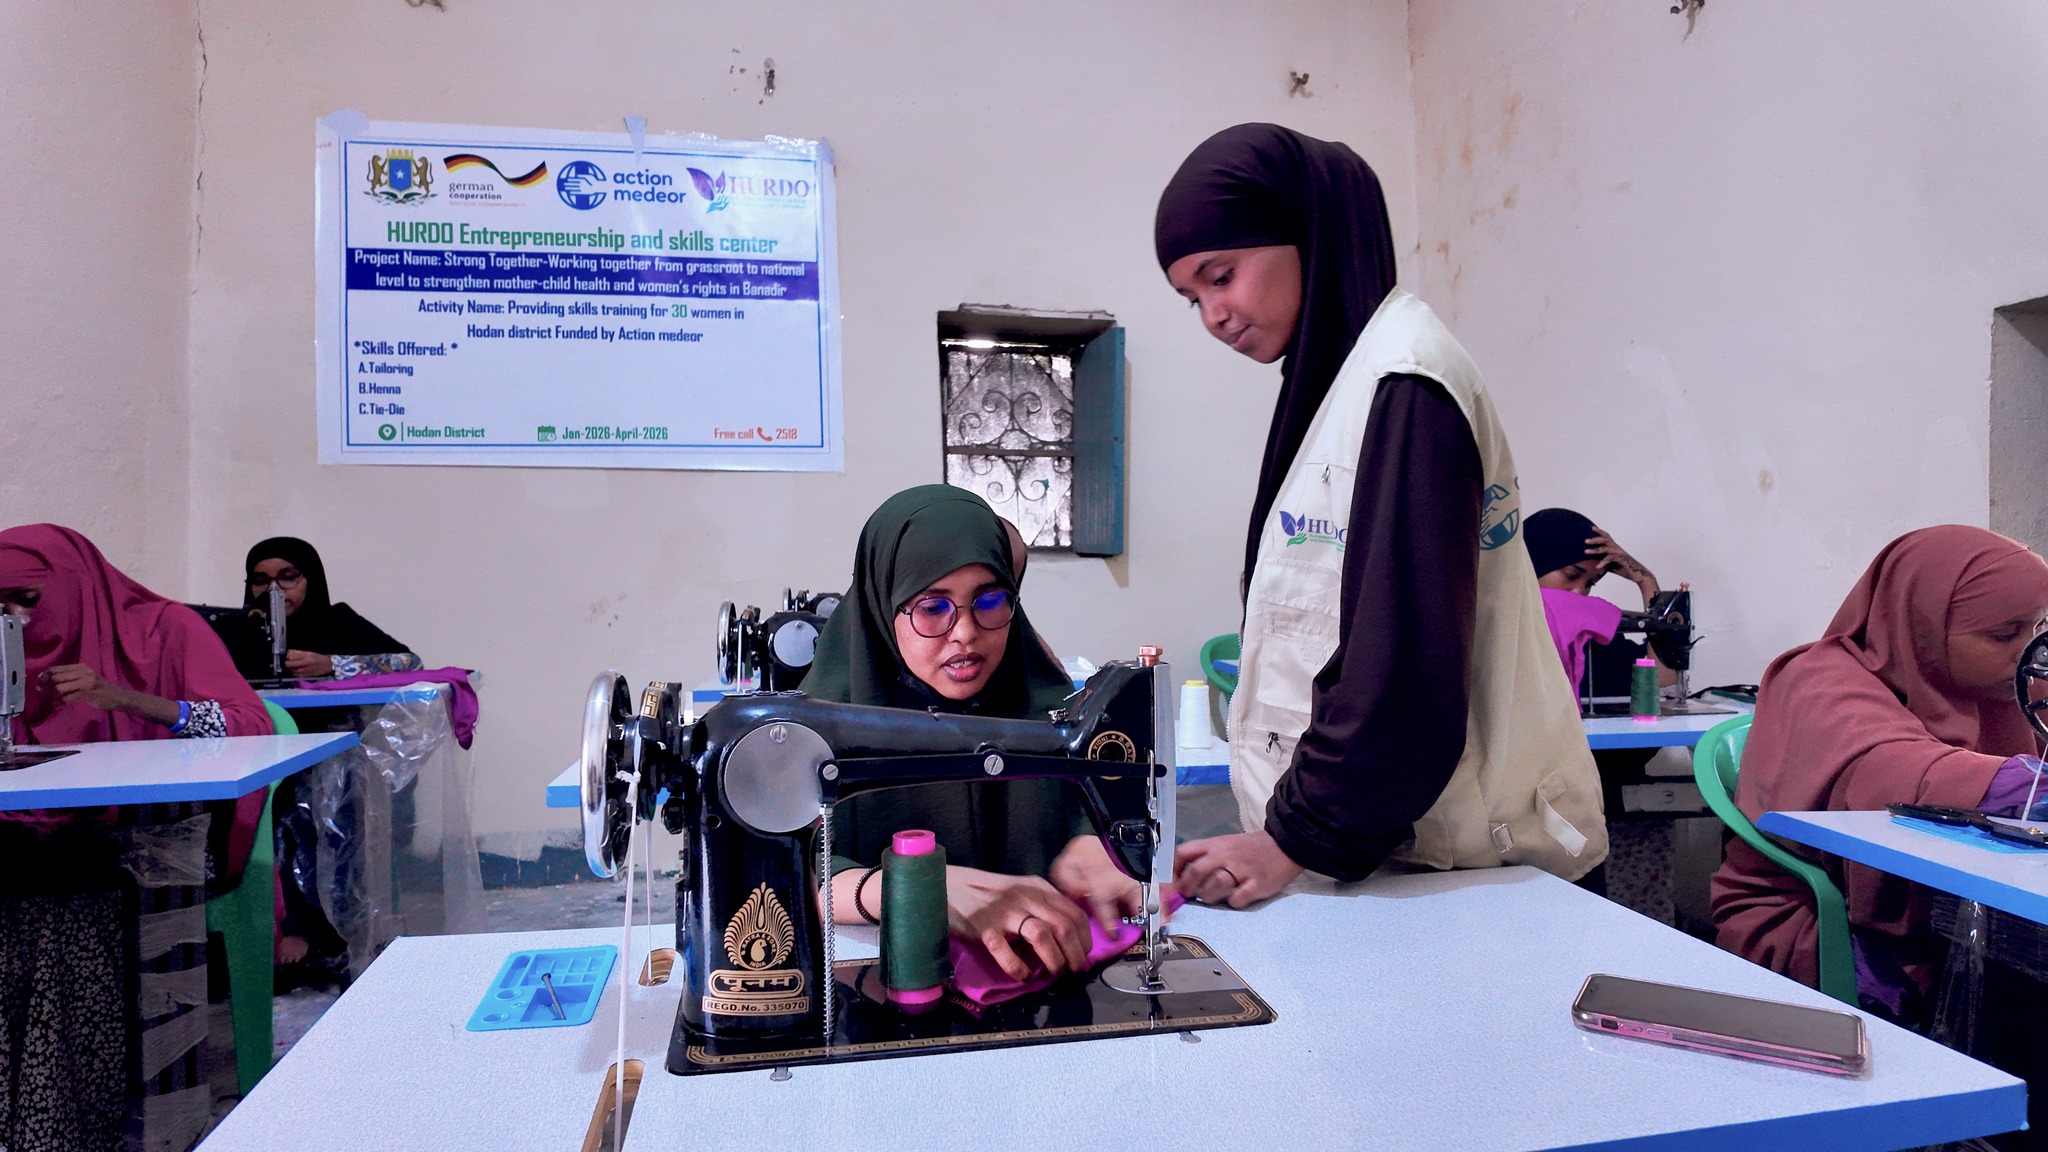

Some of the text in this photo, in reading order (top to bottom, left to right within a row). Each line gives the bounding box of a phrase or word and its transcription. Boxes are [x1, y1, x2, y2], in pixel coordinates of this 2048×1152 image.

[613, 168, 673, 187] action
[449, 181, 494, 194] german
[729, 175, 810, 198] HURDO
[449, 191, 502, 201] cooperation
[613, 186, 686, 204] medeor
[387, 220, 778, 254] HURDO Entrepreneurship and skills center
[355, 250, 805, 277] Project Name: Strong Together-Working together from grassroot to national
[376, 272, 787, 297] level to strengthen mother-child health and women's rights in Banadir
[418, 299, 745, 320] Activity Name: Providing skills training for 30 women in
[467, 324, 704, 343] Hodan district Funded by Action medeor
[398, 341, 448, 357] Offered:
[358, 361, 414, 377] A.Tailoring
[358, 382, 402, 395] B.Henna
[359, 403, 405, 416] C.Tie-Die
[407, 426, 485, 439] Hodan District
[562, 426, 668, 442] Jan-2026-April-2026
[714, 428, 798, 441] Free call 2518
[749, 960, 767, 968] INDIA
[762, 1001, 805, 1012] 335070
[753, 1051, 805, 1059] POONAM
